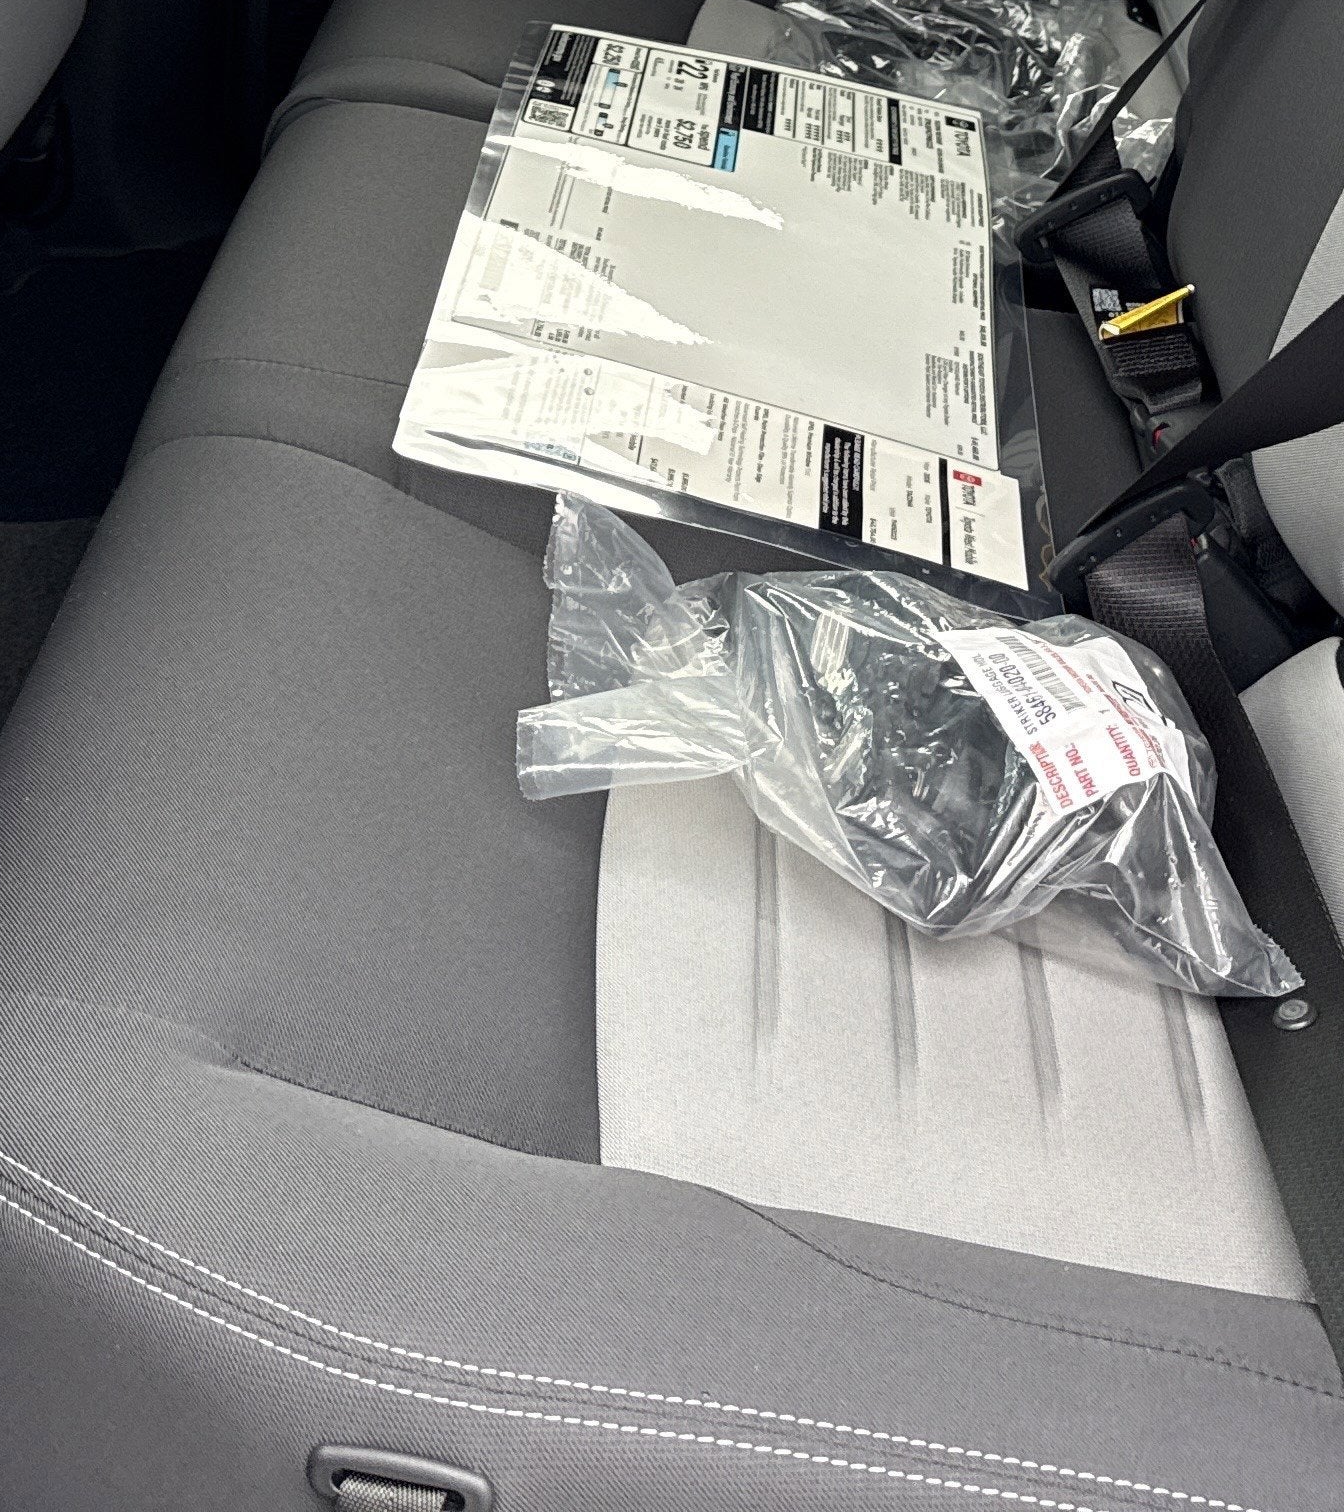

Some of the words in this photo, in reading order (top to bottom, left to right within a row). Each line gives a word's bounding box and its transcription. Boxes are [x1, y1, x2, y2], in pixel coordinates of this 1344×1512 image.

[601, 43, 625, 66] $2,250
[675, 60, 709, 80] 22
[670, 117, 696, 150] $2,750
[953, 129, 970, 158] TOYOTA
[961, 482, 976, 507] TOYOTA
[1007, 695, 1038, 735] STRIKER
[1105, 721, 1142, 777] QUANTITY:
[1073, 765, 1099, 797] PART
